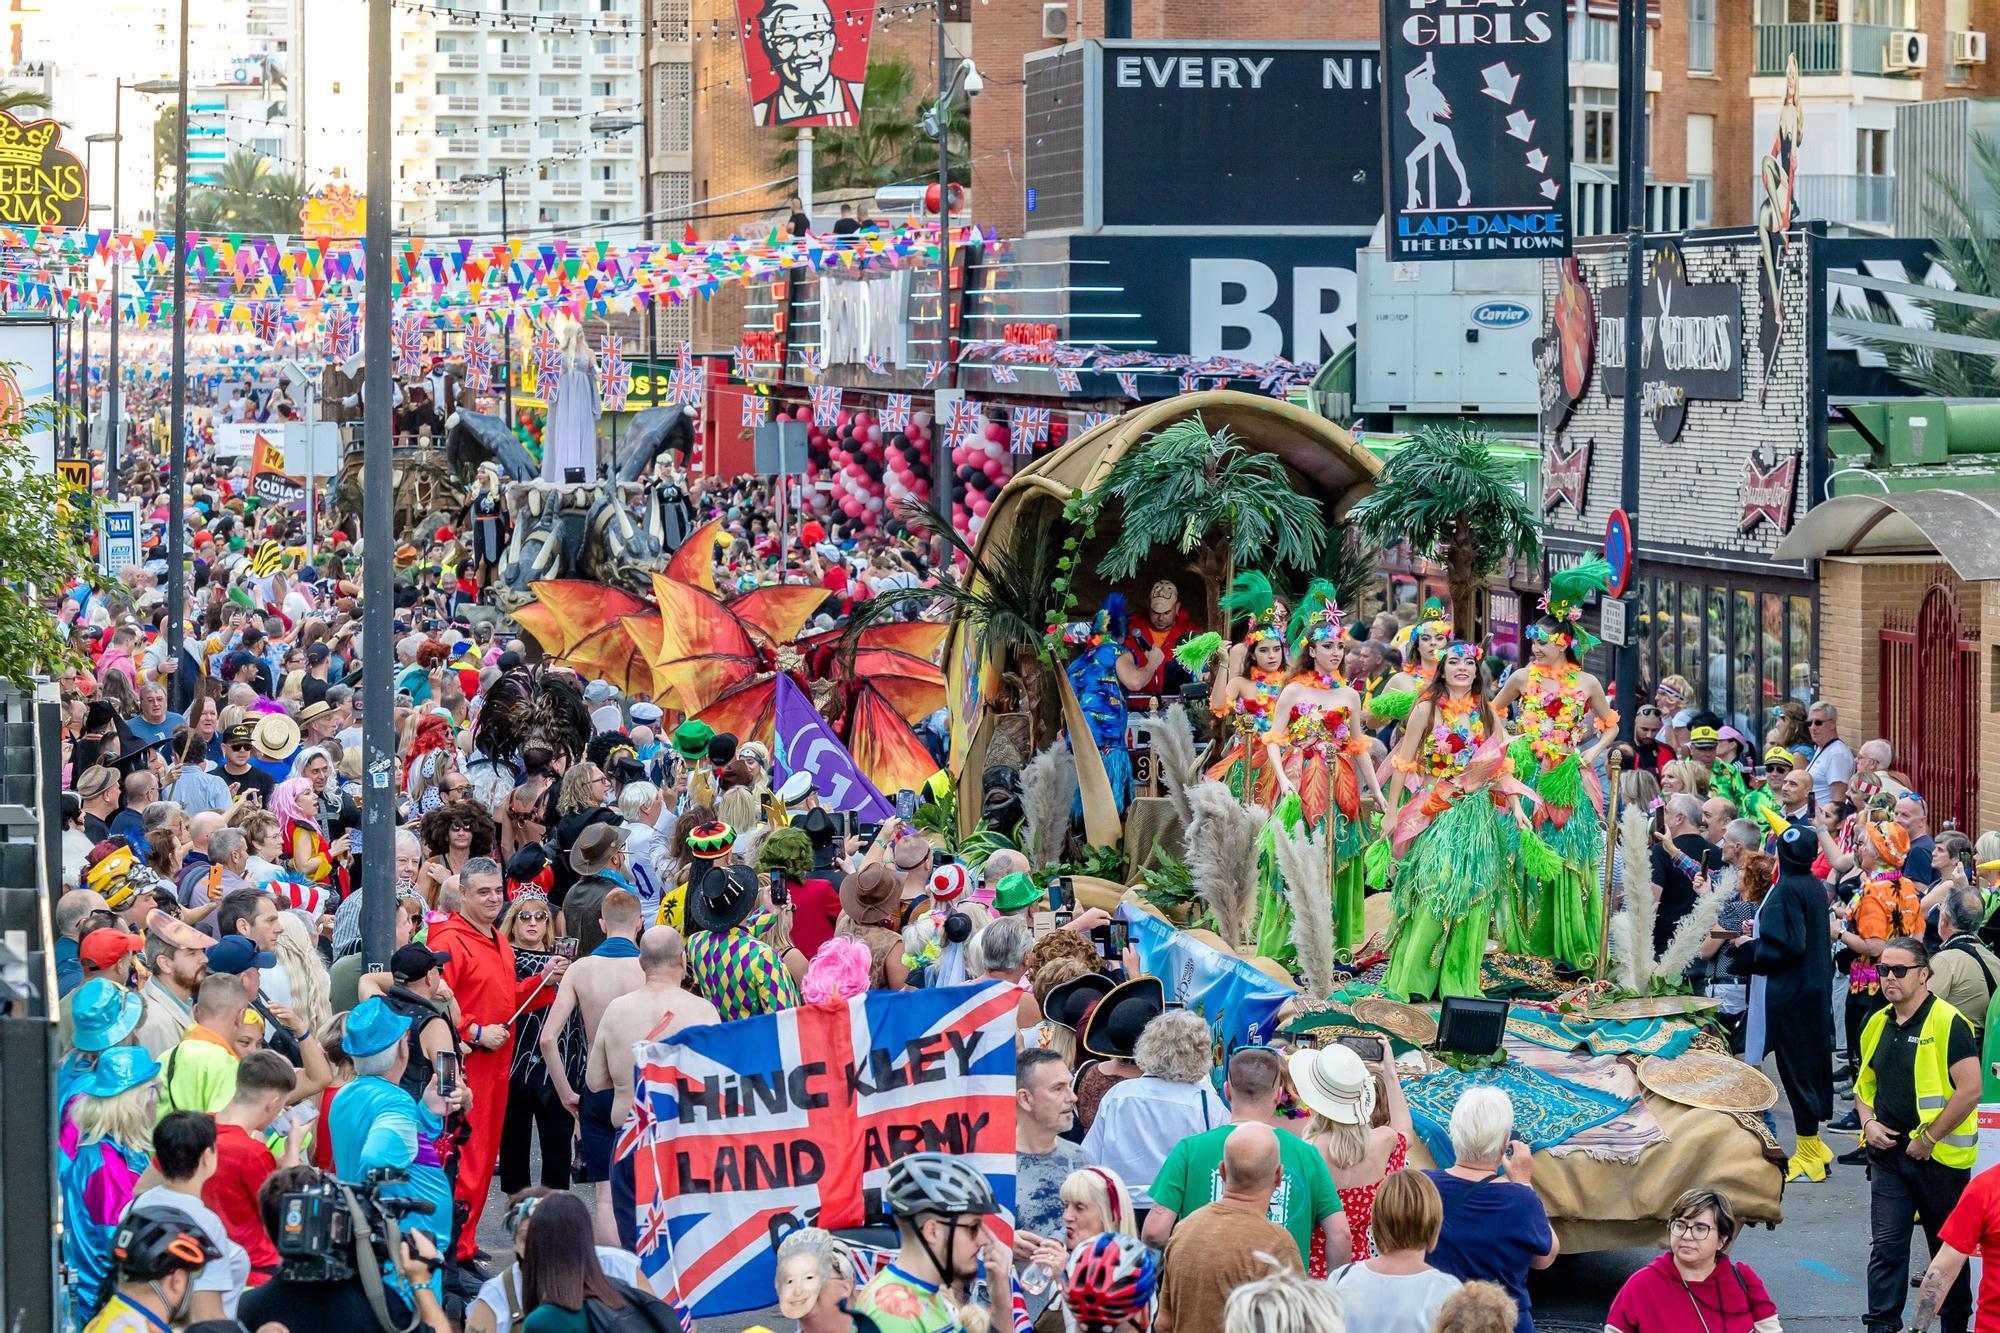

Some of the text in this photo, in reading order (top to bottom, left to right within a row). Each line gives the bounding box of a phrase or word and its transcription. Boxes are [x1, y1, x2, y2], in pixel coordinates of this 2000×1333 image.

[1402, 12, 1552, 46] GIRLS
[1116, 56, 1381, 89] EVERY NI
[1398, 213, 1564, 236] LAP-DANCE
[1400, 235, 1564, 252] THE BEST IN TOWN
[1479, 307, 1525, 321] Carrier
[1600, 316, 1657, 370] PLY
[254, 477, 305, 499] ZODIAC
[675, 1111, 991, 1196] LAND ARMY
